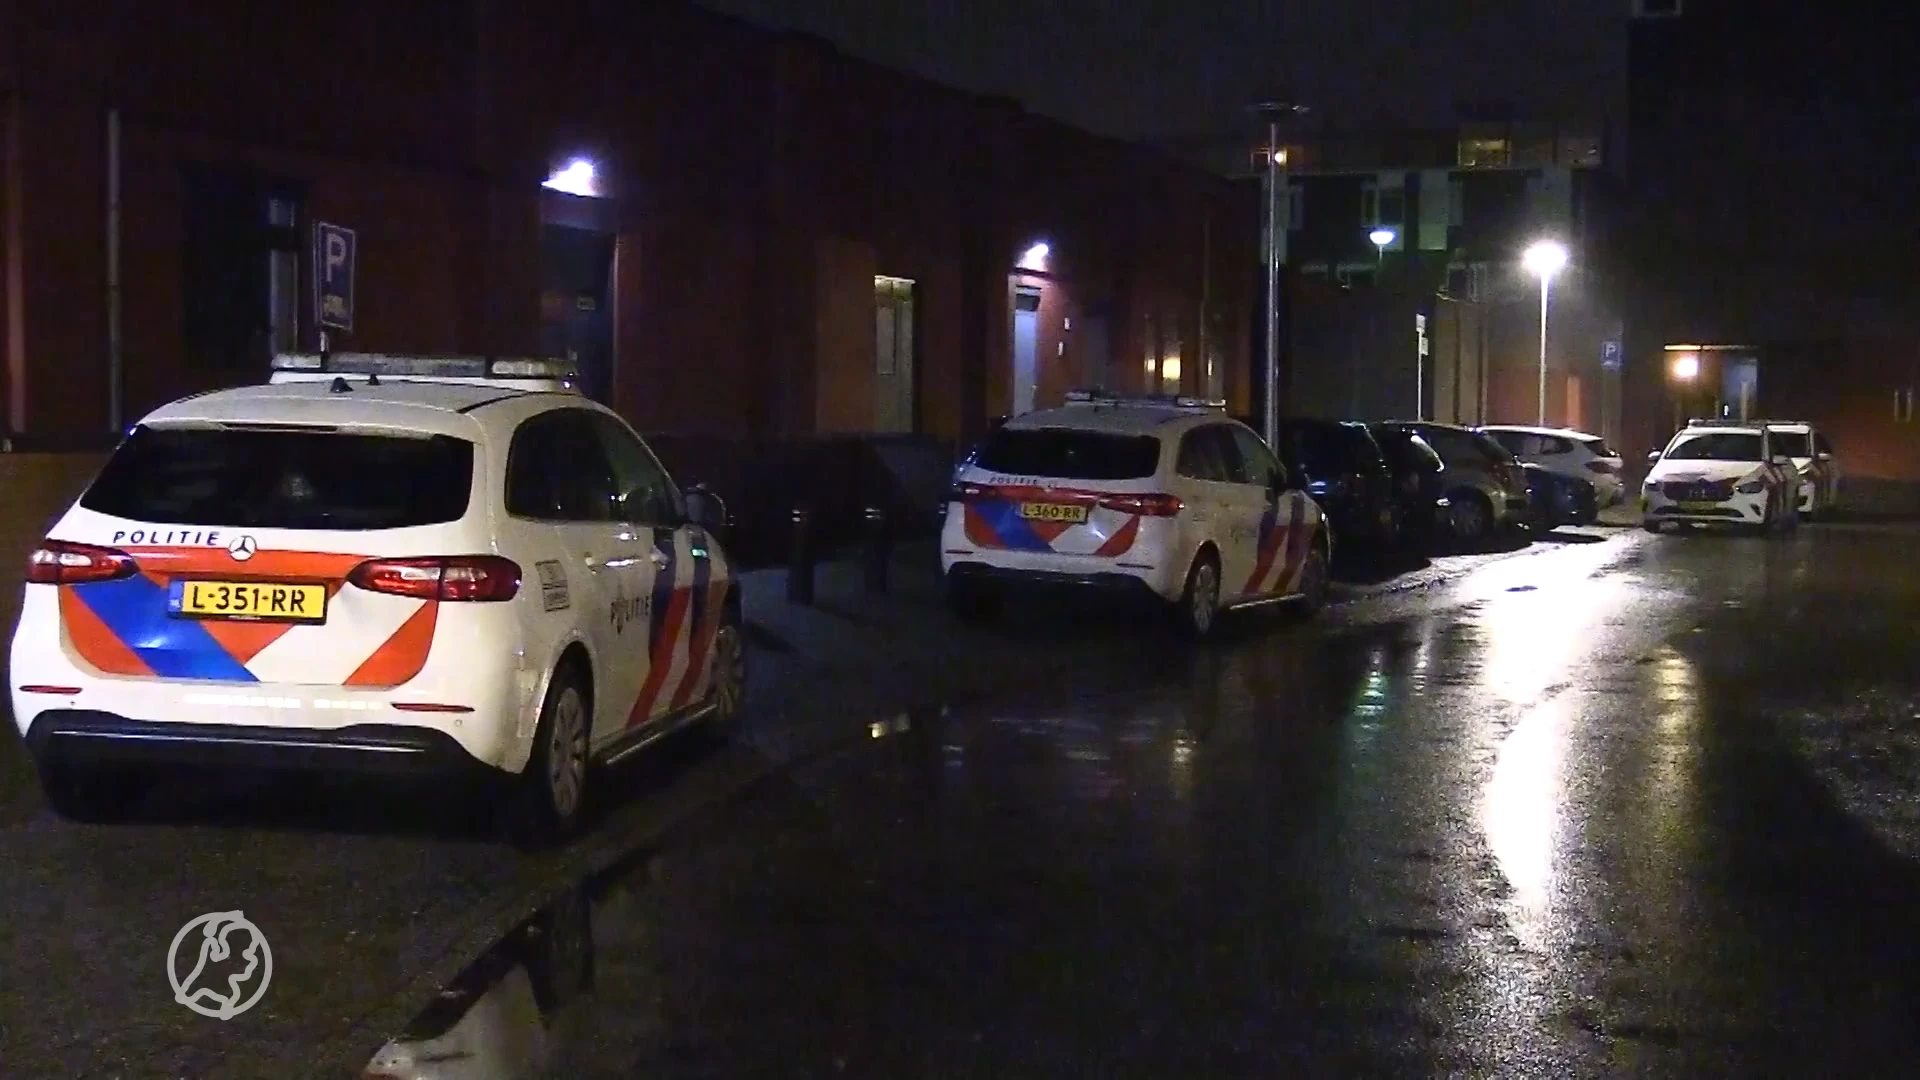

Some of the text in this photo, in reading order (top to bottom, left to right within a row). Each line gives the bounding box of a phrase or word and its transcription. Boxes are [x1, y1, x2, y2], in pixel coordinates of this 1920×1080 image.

[326, 233, 346, 282] P
[1605, 343, 1617, 358] P
[112, 531, 220, 545] POLITIE
[192, 585, 306, 613] L-351-RR
